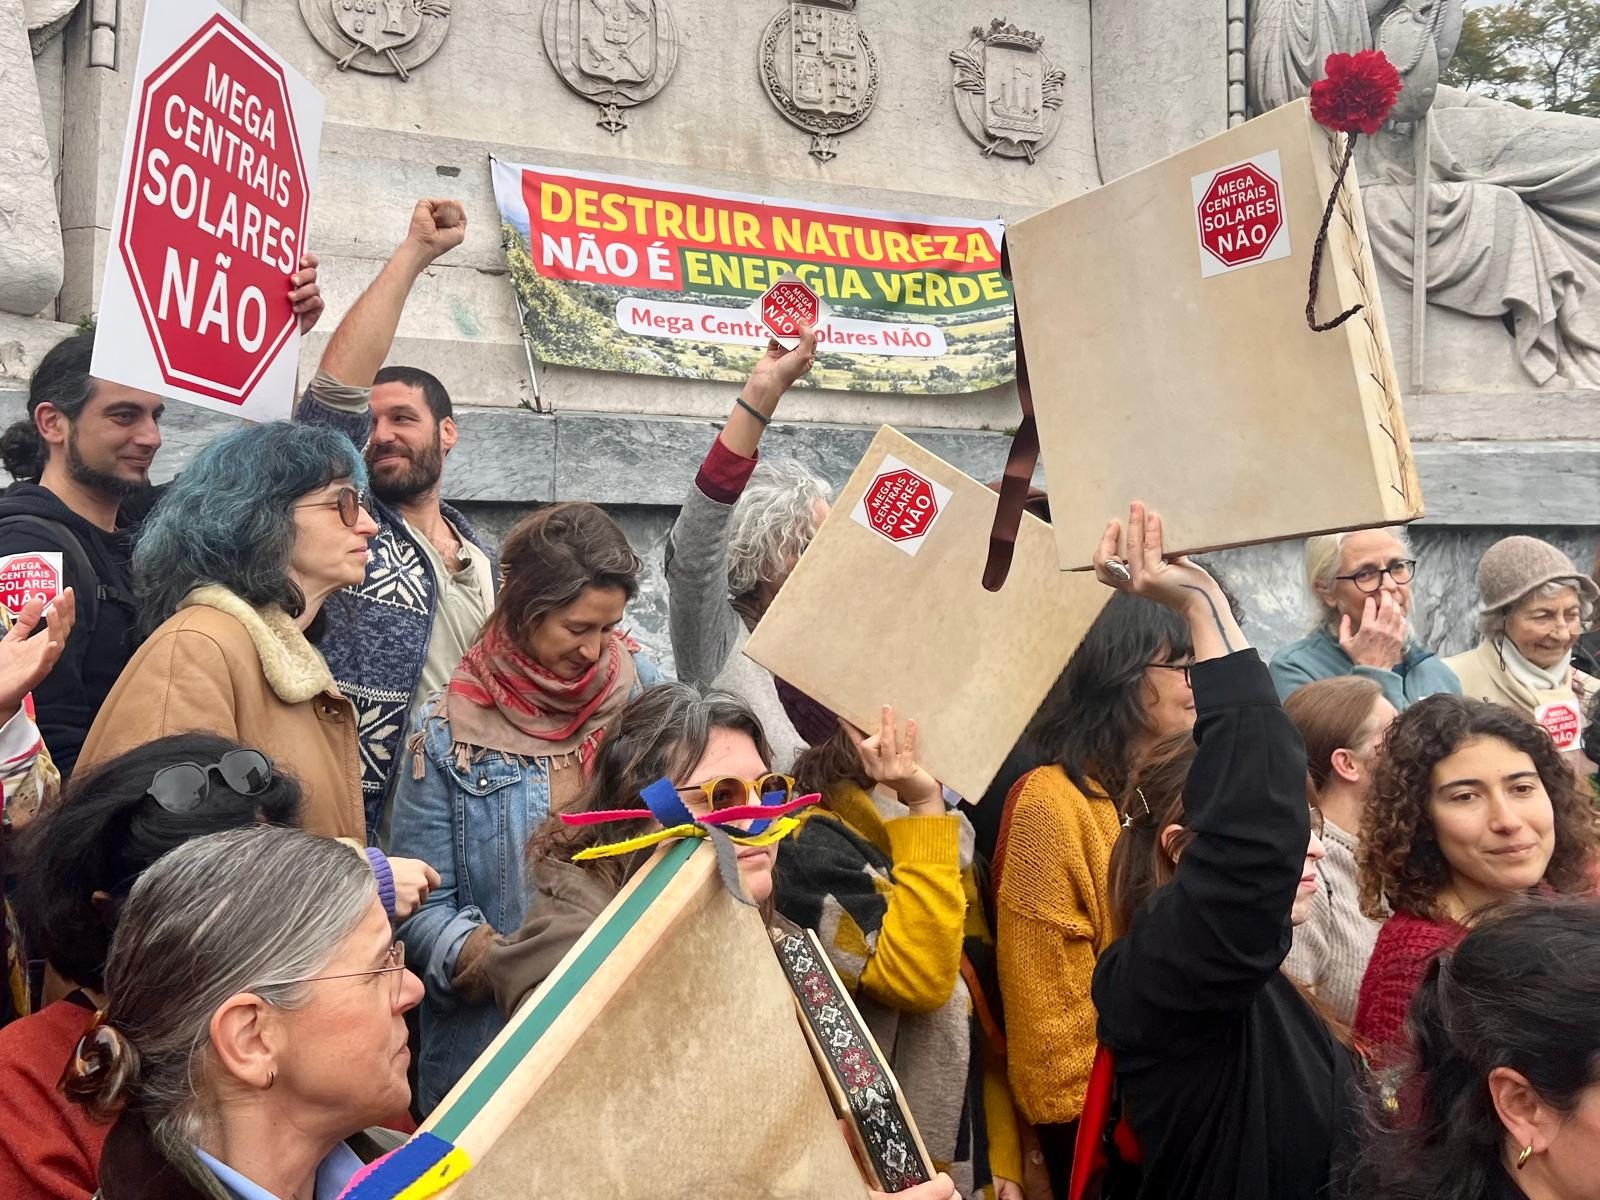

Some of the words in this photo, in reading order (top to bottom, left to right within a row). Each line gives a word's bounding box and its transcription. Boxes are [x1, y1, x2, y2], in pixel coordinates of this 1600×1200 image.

[204, 62, 276, 150] MEGA
[163, 94, 291, 209] CENTRAIS
[1206, 185, 1267, 213] CENTRAIS
[1218, 176, 1254, 196] MEGA
[143, 148, 296, 275] SOLARES
[540, 181, 765, 249] DESTRUIR
[772, 216, 996, 264] NATUREZA
[1204, 198, 1276, 232] SOLARES
[1217, 224, 1267, 254] NÃO
[541, 232, 638, 278] NÃO
[646, 241, 675, 281] É
[873, 271, 1008, 308] VERDE
[157, 246, 267, 354] NÃO
[770, 290, 803, 324] SOLAR
[780, 286, 813, 320] CENTRAIS
[792, 287, 813, 310] MEGA
[631, 307, 694, 334] Mega
[701, 315, 773, 338] Centr
[815, 324, 878, 346] olares
[882, 327, 932, 347] NÃO
[765, 304, 794, 334] NÃO
[871, 480, 894, 509] MEGA
[874, 476, 907, 524] CENTRAIS
[881, 478, 920, 533] SOLARES
[899, 495, 931, 535] NÃO
[0, 570, 50, 580] CENTRAIS
[11, 561, 41, 571] MEGA
[0, 579, 56, 592] SOLARES
